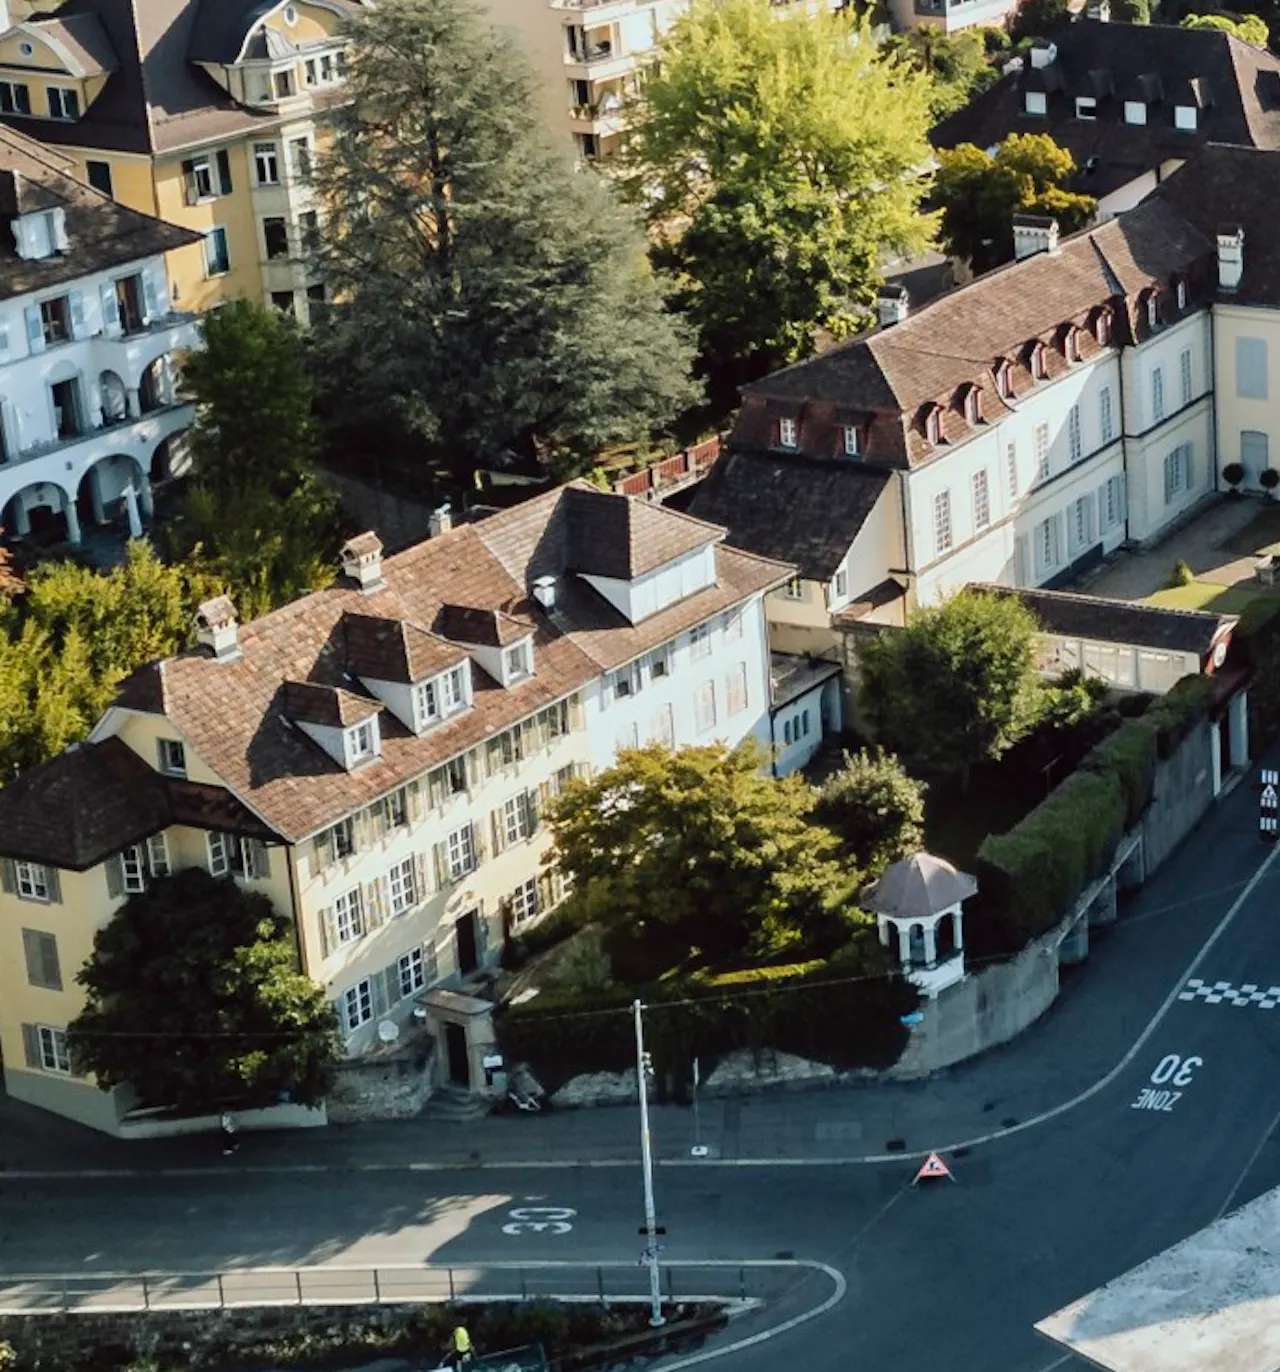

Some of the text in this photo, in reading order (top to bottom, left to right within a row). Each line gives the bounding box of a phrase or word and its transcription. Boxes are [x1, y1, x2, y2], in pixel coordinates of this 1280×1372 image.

[1150, 1054, 1203, 1087] 30
[1131, 1088, 1182, 1111] ZONE
[501, 1207, 577, 1235] 30
